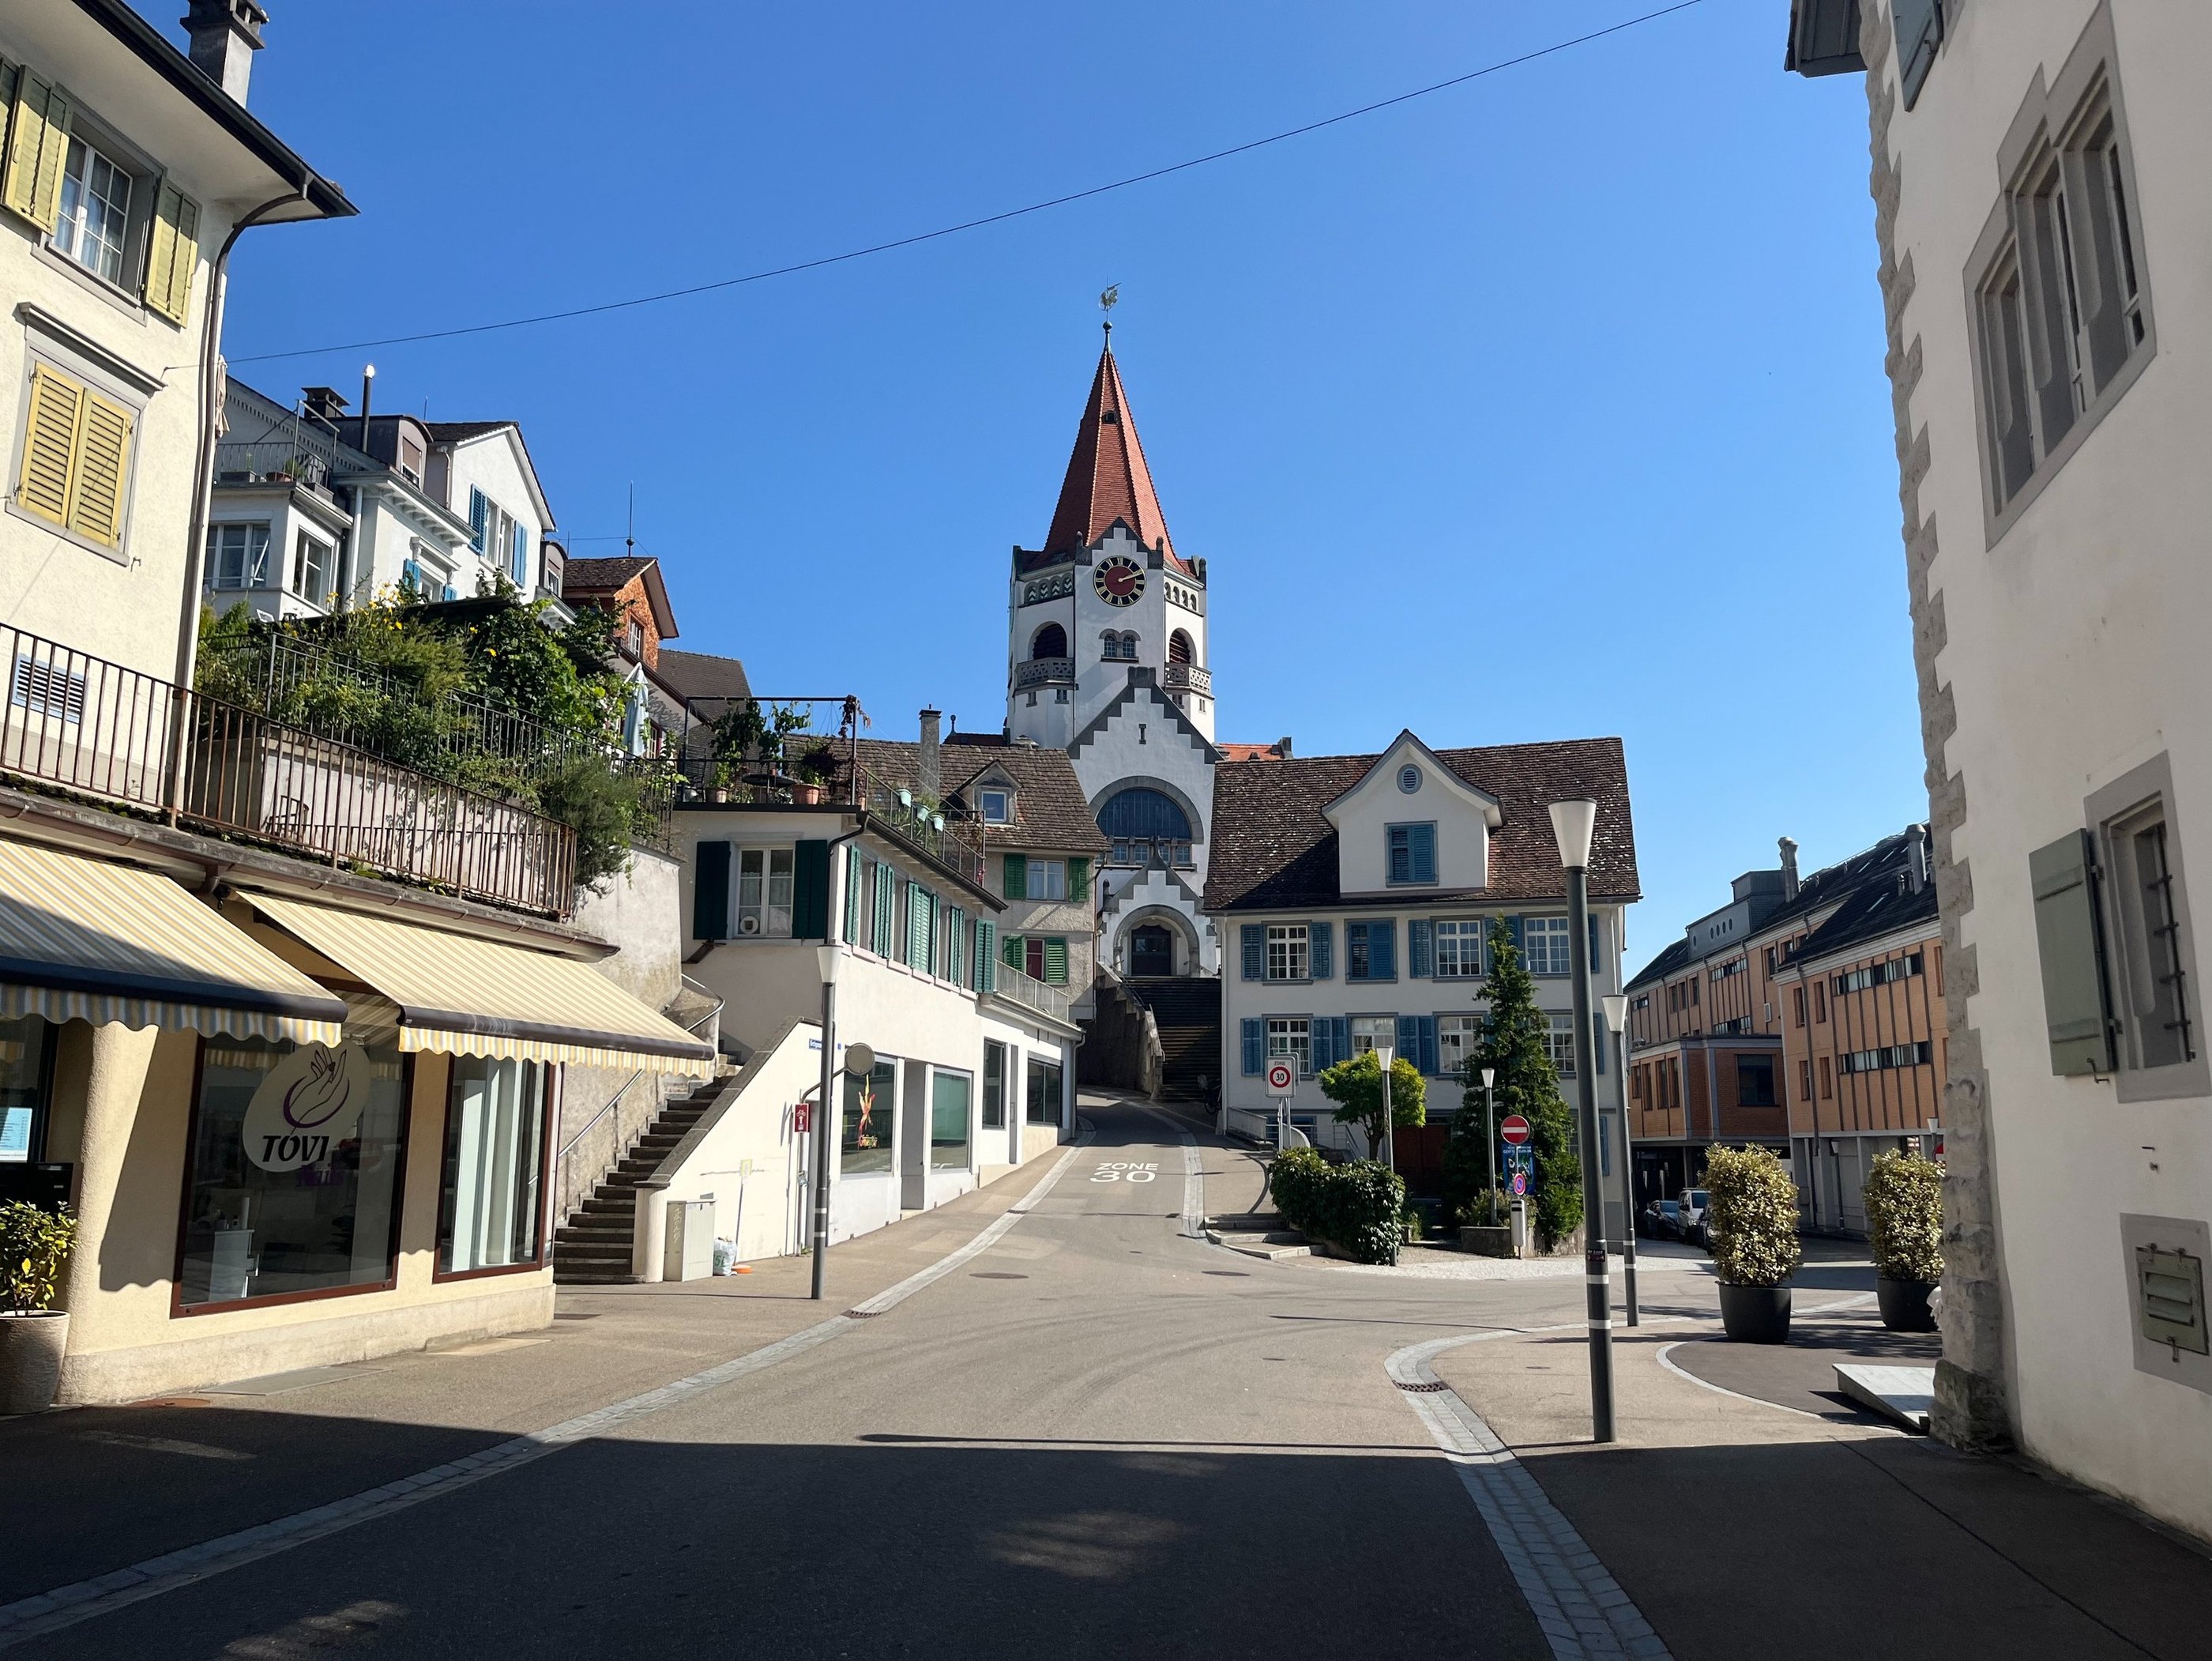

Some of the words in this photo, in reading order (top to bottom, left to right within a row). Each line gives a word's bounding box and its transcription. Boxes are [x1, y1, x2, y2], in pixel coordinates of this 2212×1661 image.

[1275, 1072, 1285, 1082] 30
[262, 1135, 330, 1162] TOVI
[1089, 1170, 1156, 1183] 30
